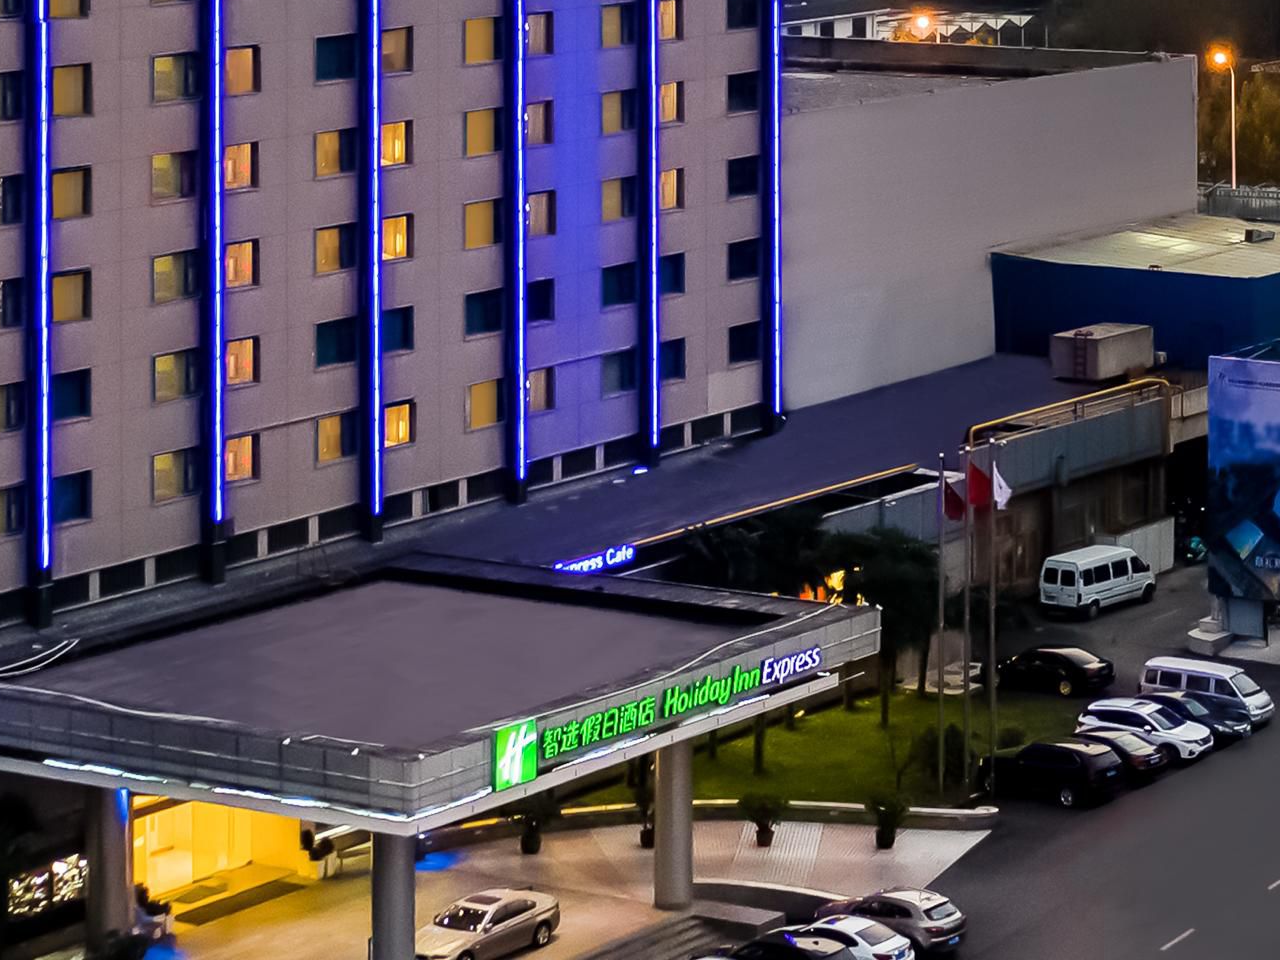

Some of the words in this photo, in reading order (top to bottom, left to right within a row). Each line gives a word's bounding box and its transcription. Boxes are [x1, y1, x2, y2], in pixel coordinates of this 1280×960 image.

[664, 675, 732, 718] Holiday
[733, 665, 761, 693] Inn
[762, 647, 821, 685] Express
[543, 696, 656, 759] 智选假日酒店
